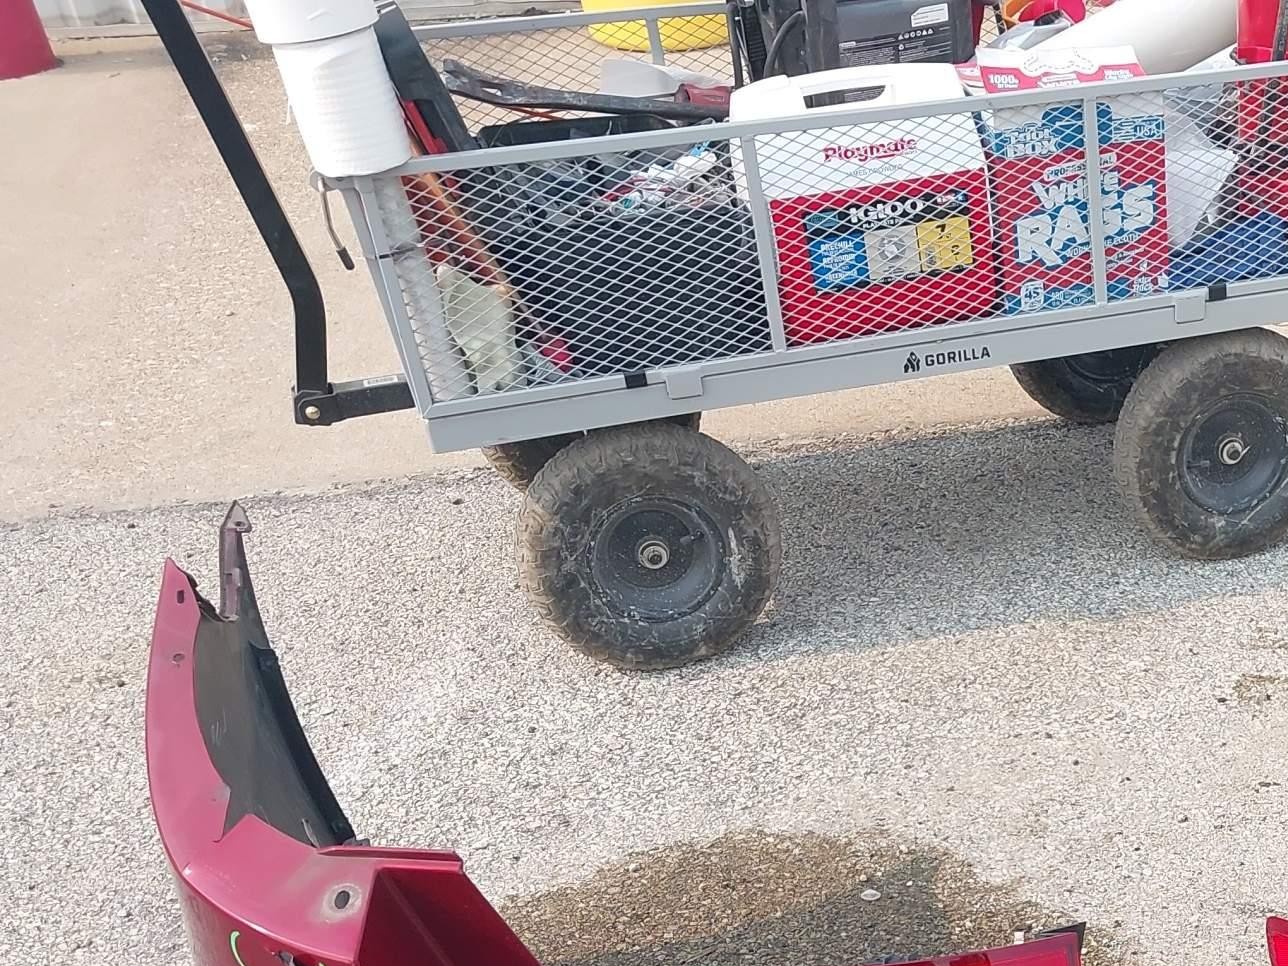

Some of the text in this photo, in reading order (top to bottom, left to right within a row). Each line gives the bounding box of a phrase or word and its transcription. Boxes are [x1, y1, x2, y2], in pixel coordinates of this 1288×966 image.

[823, 137, 917, 162] Playmate
[850, 198, 924, 223] IGLOO
[925, 347, 990, 366] GORILLA
